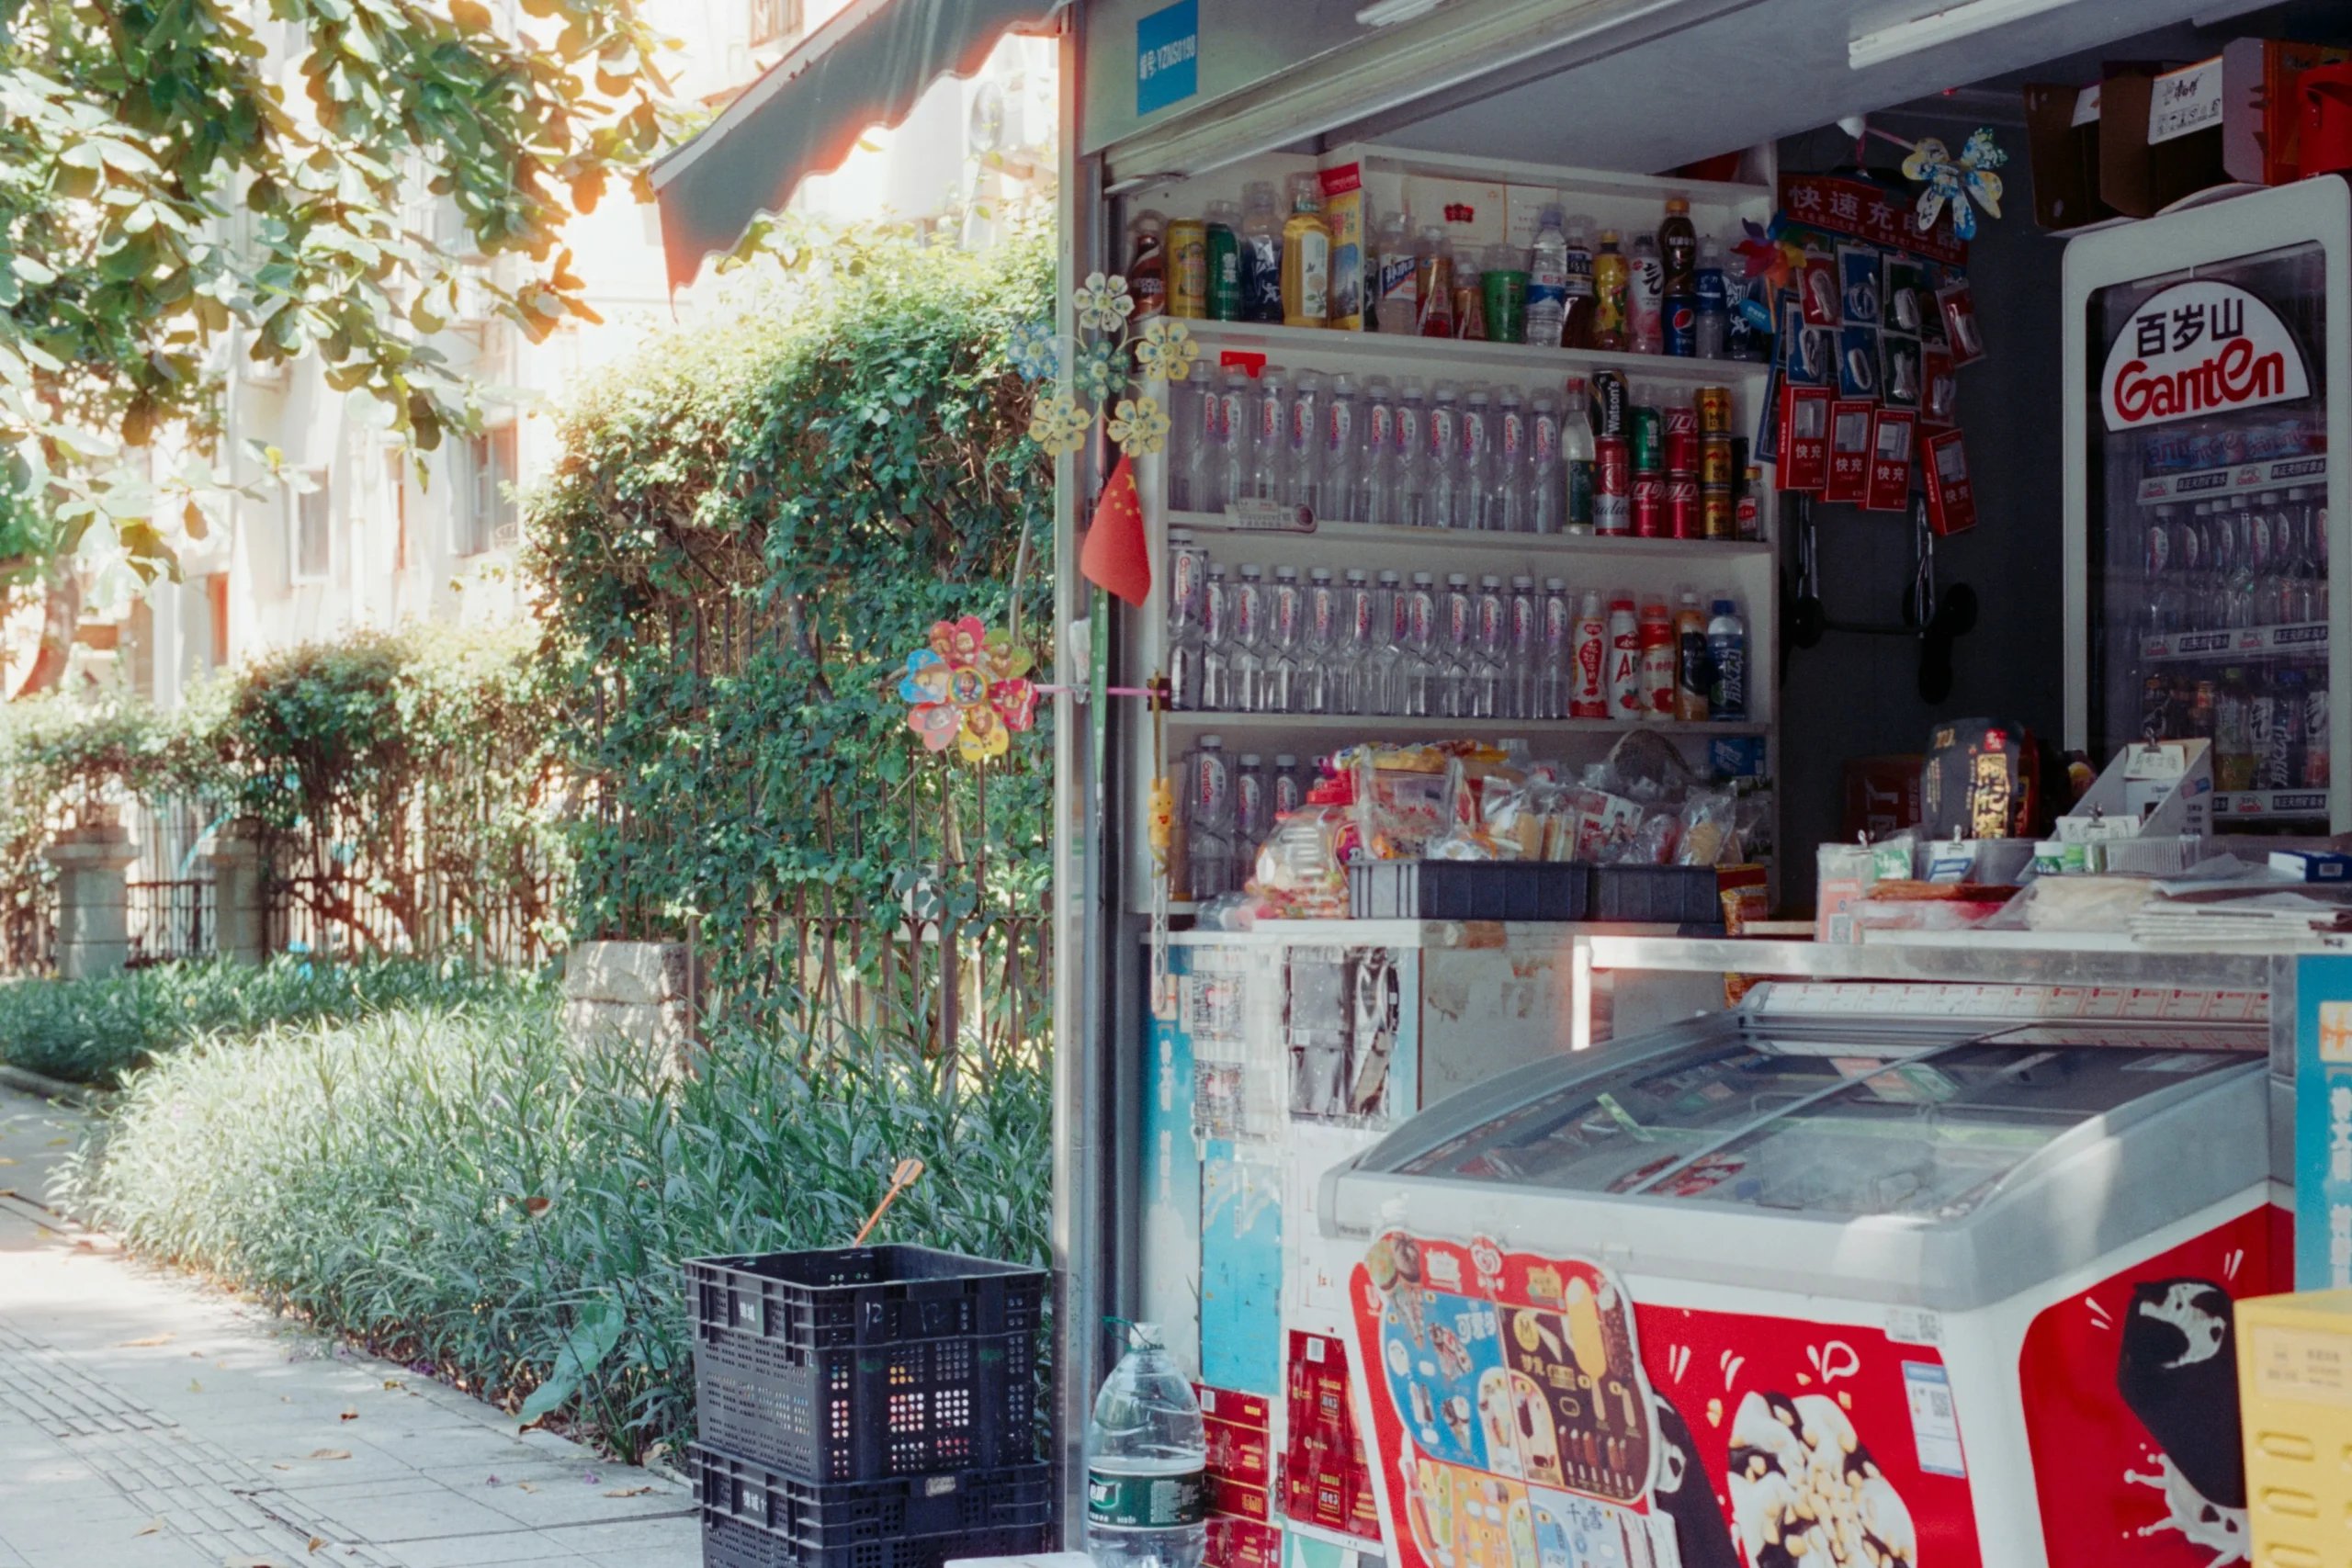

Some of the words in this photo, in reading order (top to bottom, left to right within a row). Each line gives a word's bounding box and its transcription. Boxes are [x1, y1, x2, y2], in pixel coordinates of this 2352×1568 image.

[2136, 298, 2244, 358] 百岁山
[1608, 381, 1621, 434] Watson's
[1795, 444, 1822, 459] 快充
[1835, 457, 1863, 473] 快充
[1877, 465, 1905, 482] 快充
